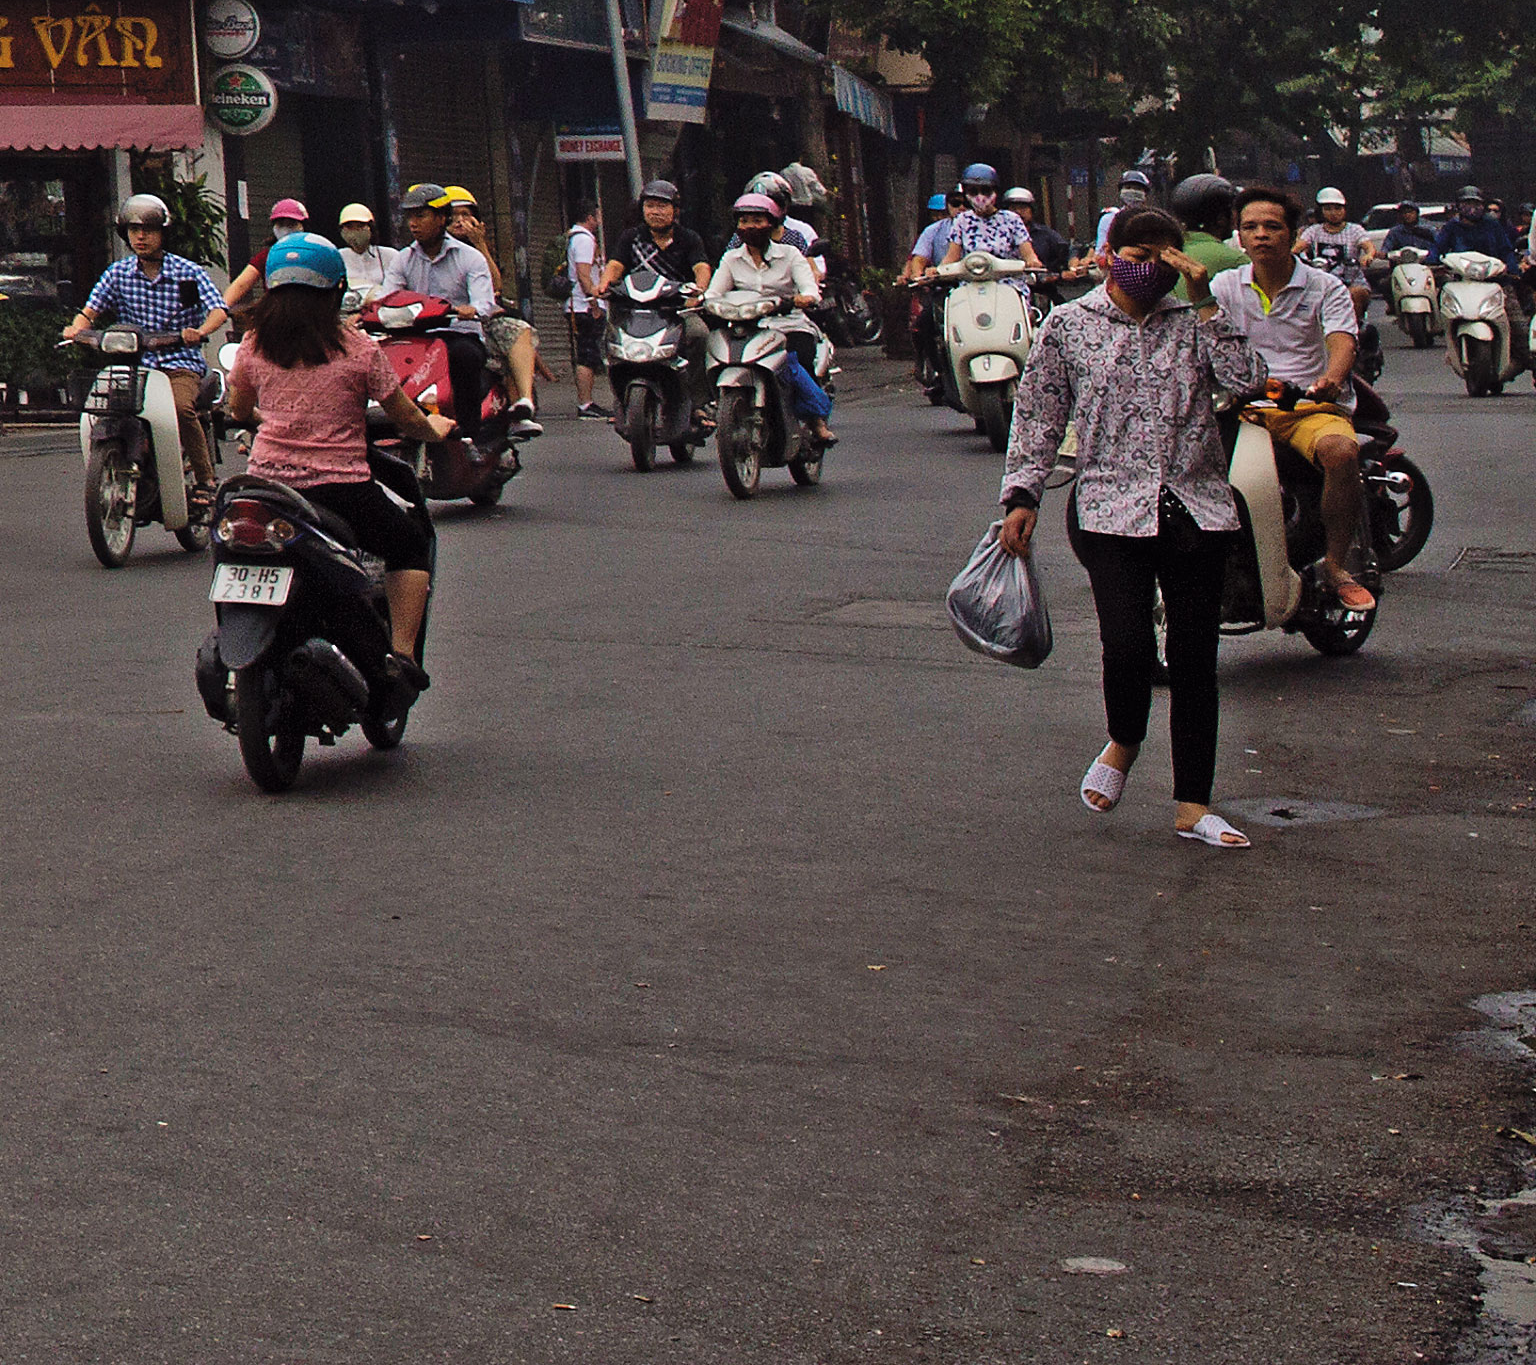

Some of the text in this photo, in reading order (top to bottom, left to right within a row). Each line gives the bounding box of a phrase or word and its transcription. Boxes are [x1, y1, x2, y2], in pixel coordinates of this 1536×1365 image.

[31, 3, 162, 69] VÂN
[212, 92, 269, 106] eineken
[227, 566, 281, 584] 30-H5
[221, 582, 275, 601] 2381
